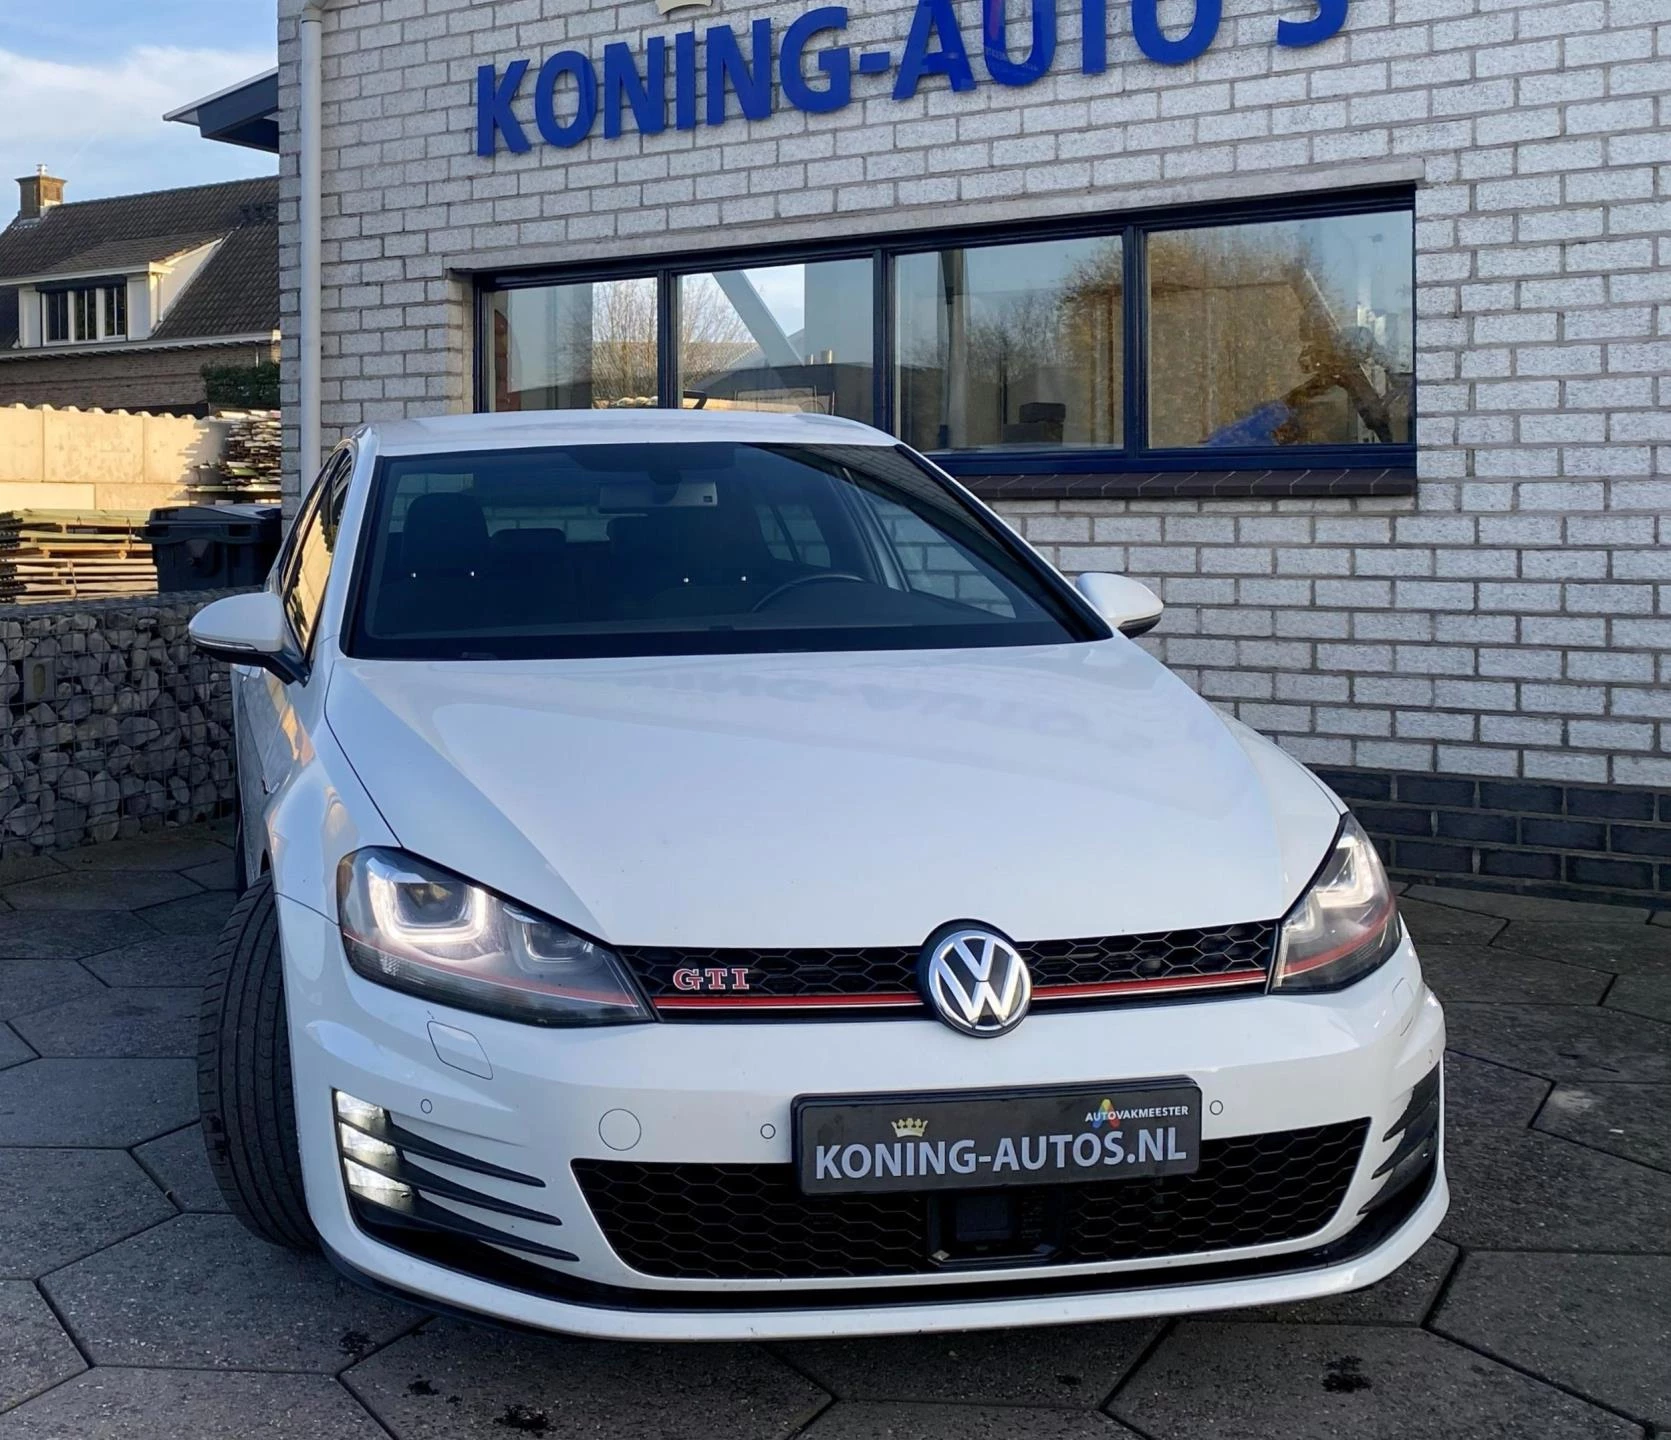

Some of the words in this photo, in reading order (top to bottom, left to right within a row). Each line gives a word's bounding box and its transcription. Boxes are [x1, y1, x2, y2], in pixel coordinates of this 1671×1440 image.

[672, 968, 750, 991] GTI
[1085, 1106, 1189, 1122] AUTOVAKMEESTER
[815, 1127, 1187, 1180] KONING-AUTOS.NL
